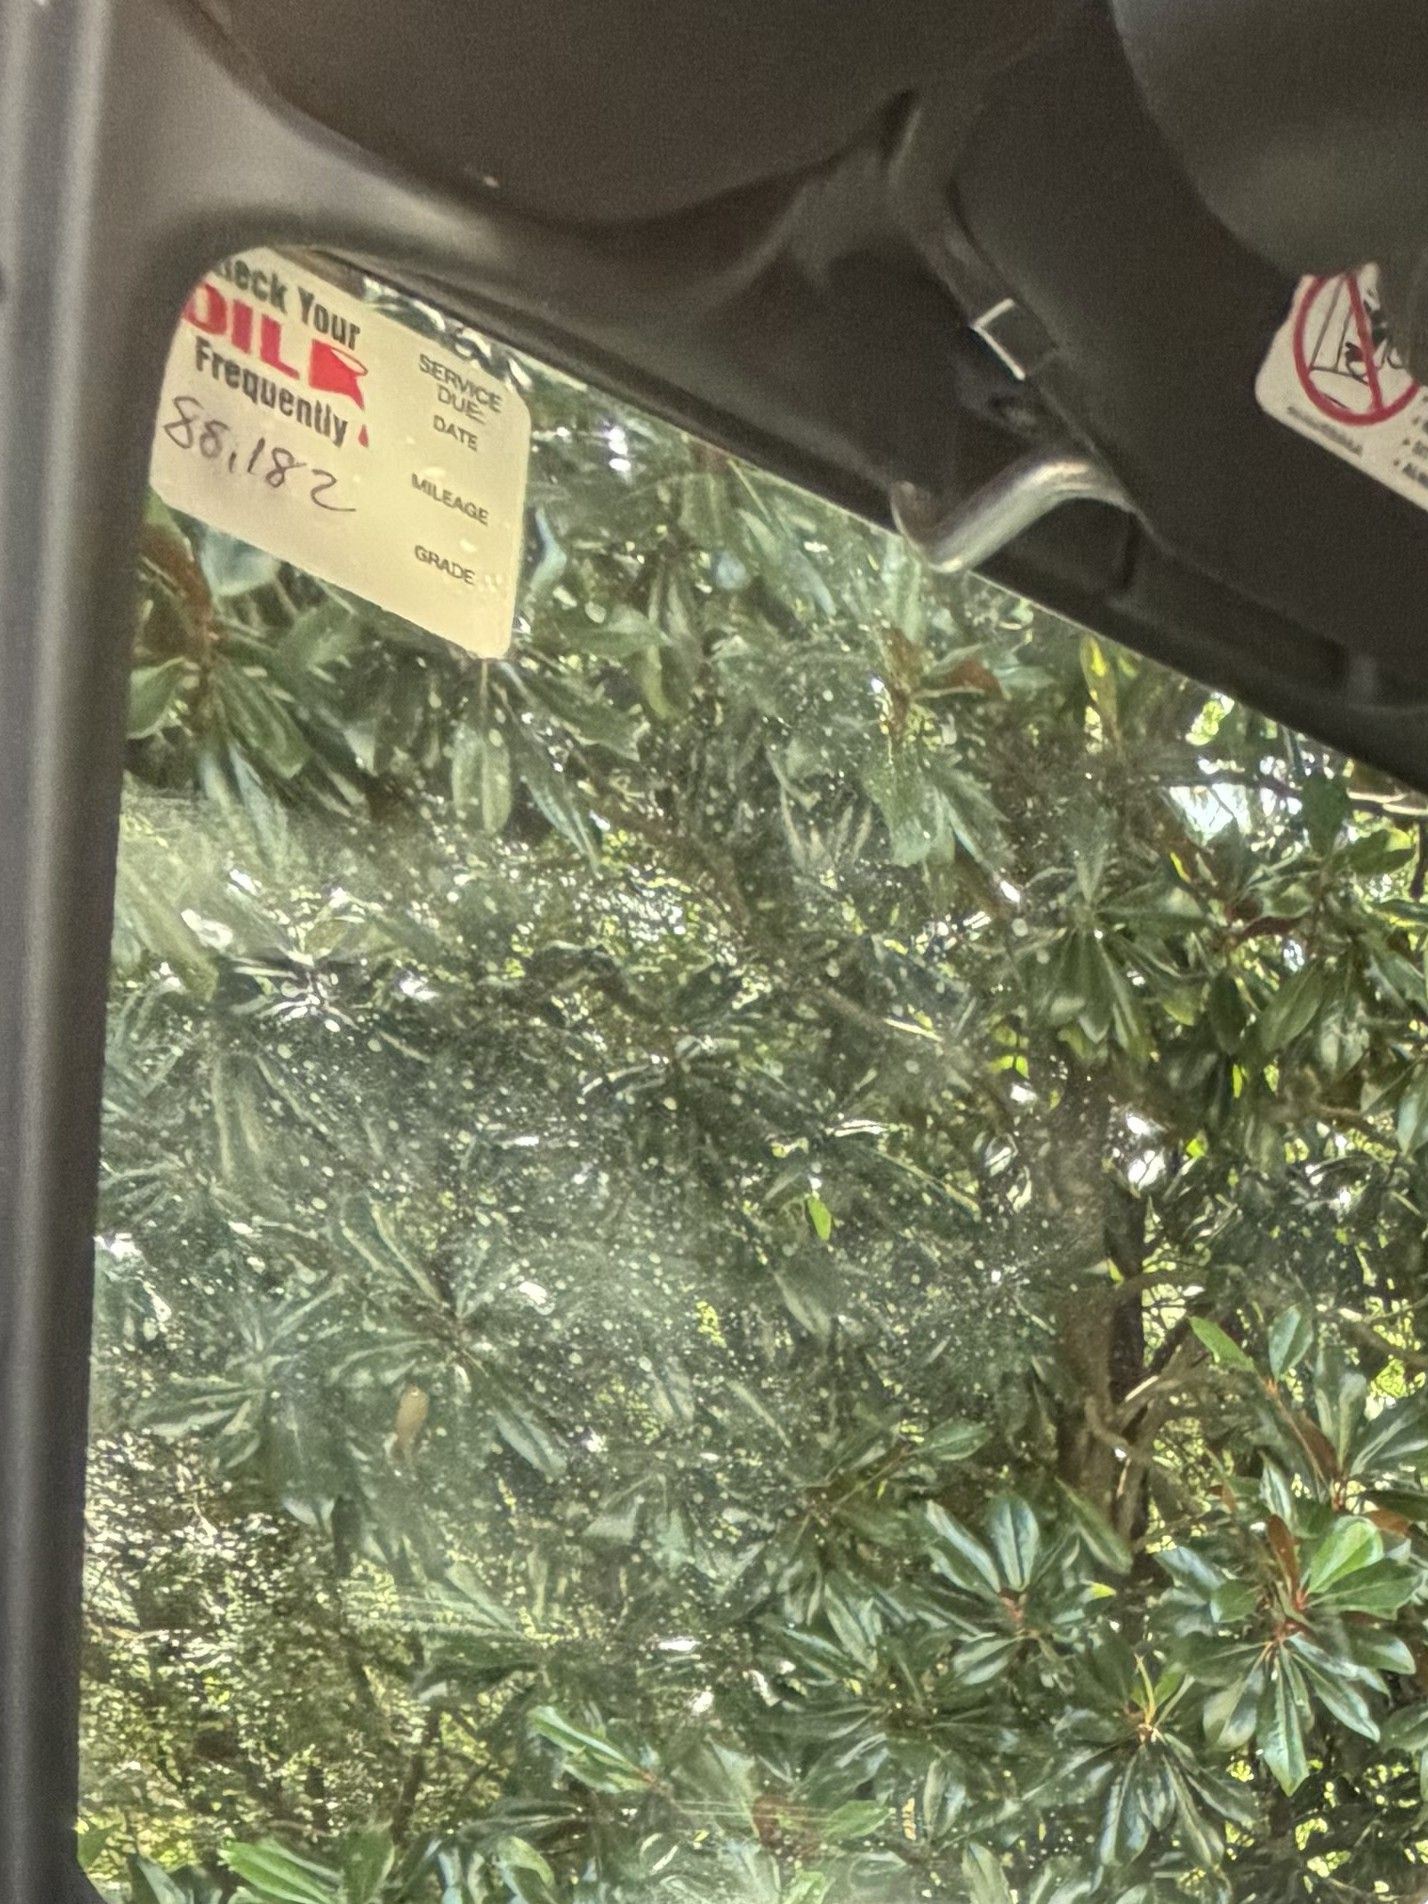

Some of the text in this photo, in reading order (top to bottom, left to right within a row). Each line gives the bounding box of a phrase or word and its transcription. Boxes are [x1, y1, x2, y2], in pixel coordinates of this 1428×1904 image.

[184, 283, 300, 380] OIL
[298, 286, 361, 350] Your
[194, 335, 348, 447] Frequently
[419, 354, 501, 413] SERVICE
[433, 414, 478, 451] DATE
[411, 472, 489, 526] MILEAGE
[414, 544, 475, 587] GRADE
